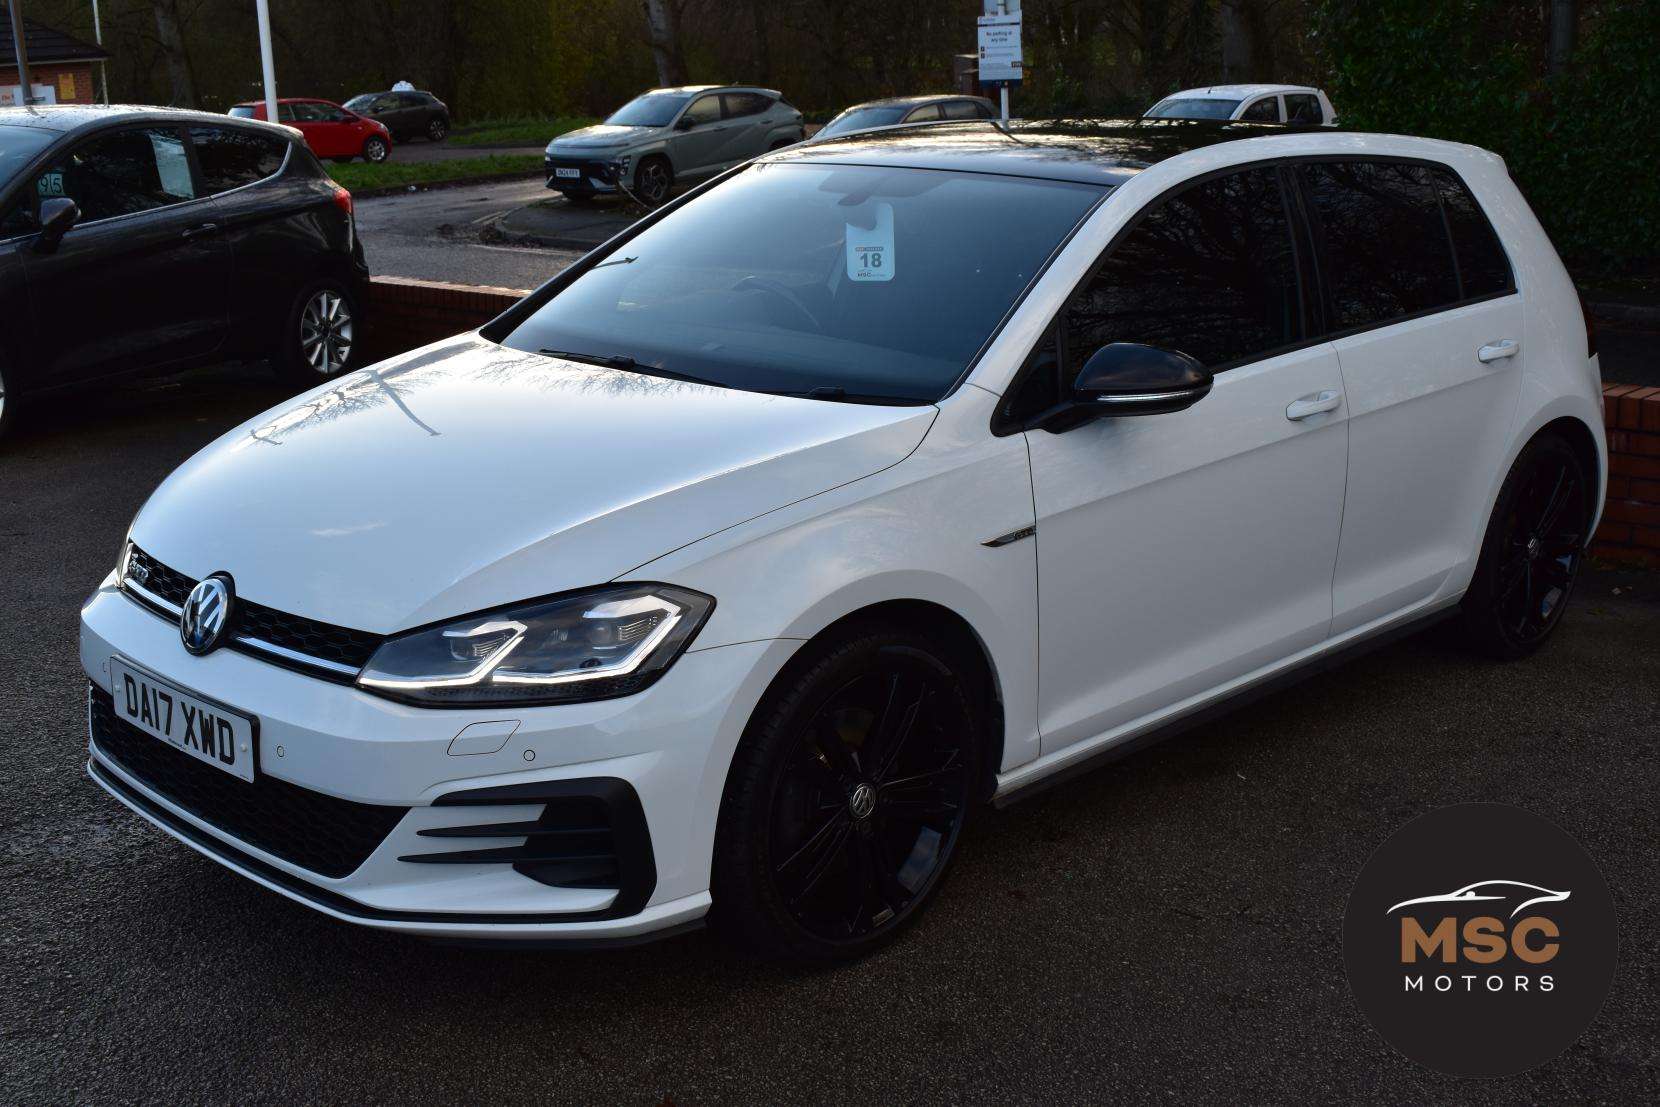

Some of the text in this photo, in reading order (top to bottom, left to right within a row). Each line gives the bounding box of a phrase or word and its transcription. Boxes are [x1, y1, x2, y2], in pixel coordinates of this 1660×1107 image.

[860, 252, 882, 268] 18
[123, 672, 236, 766] DA17 XWD
